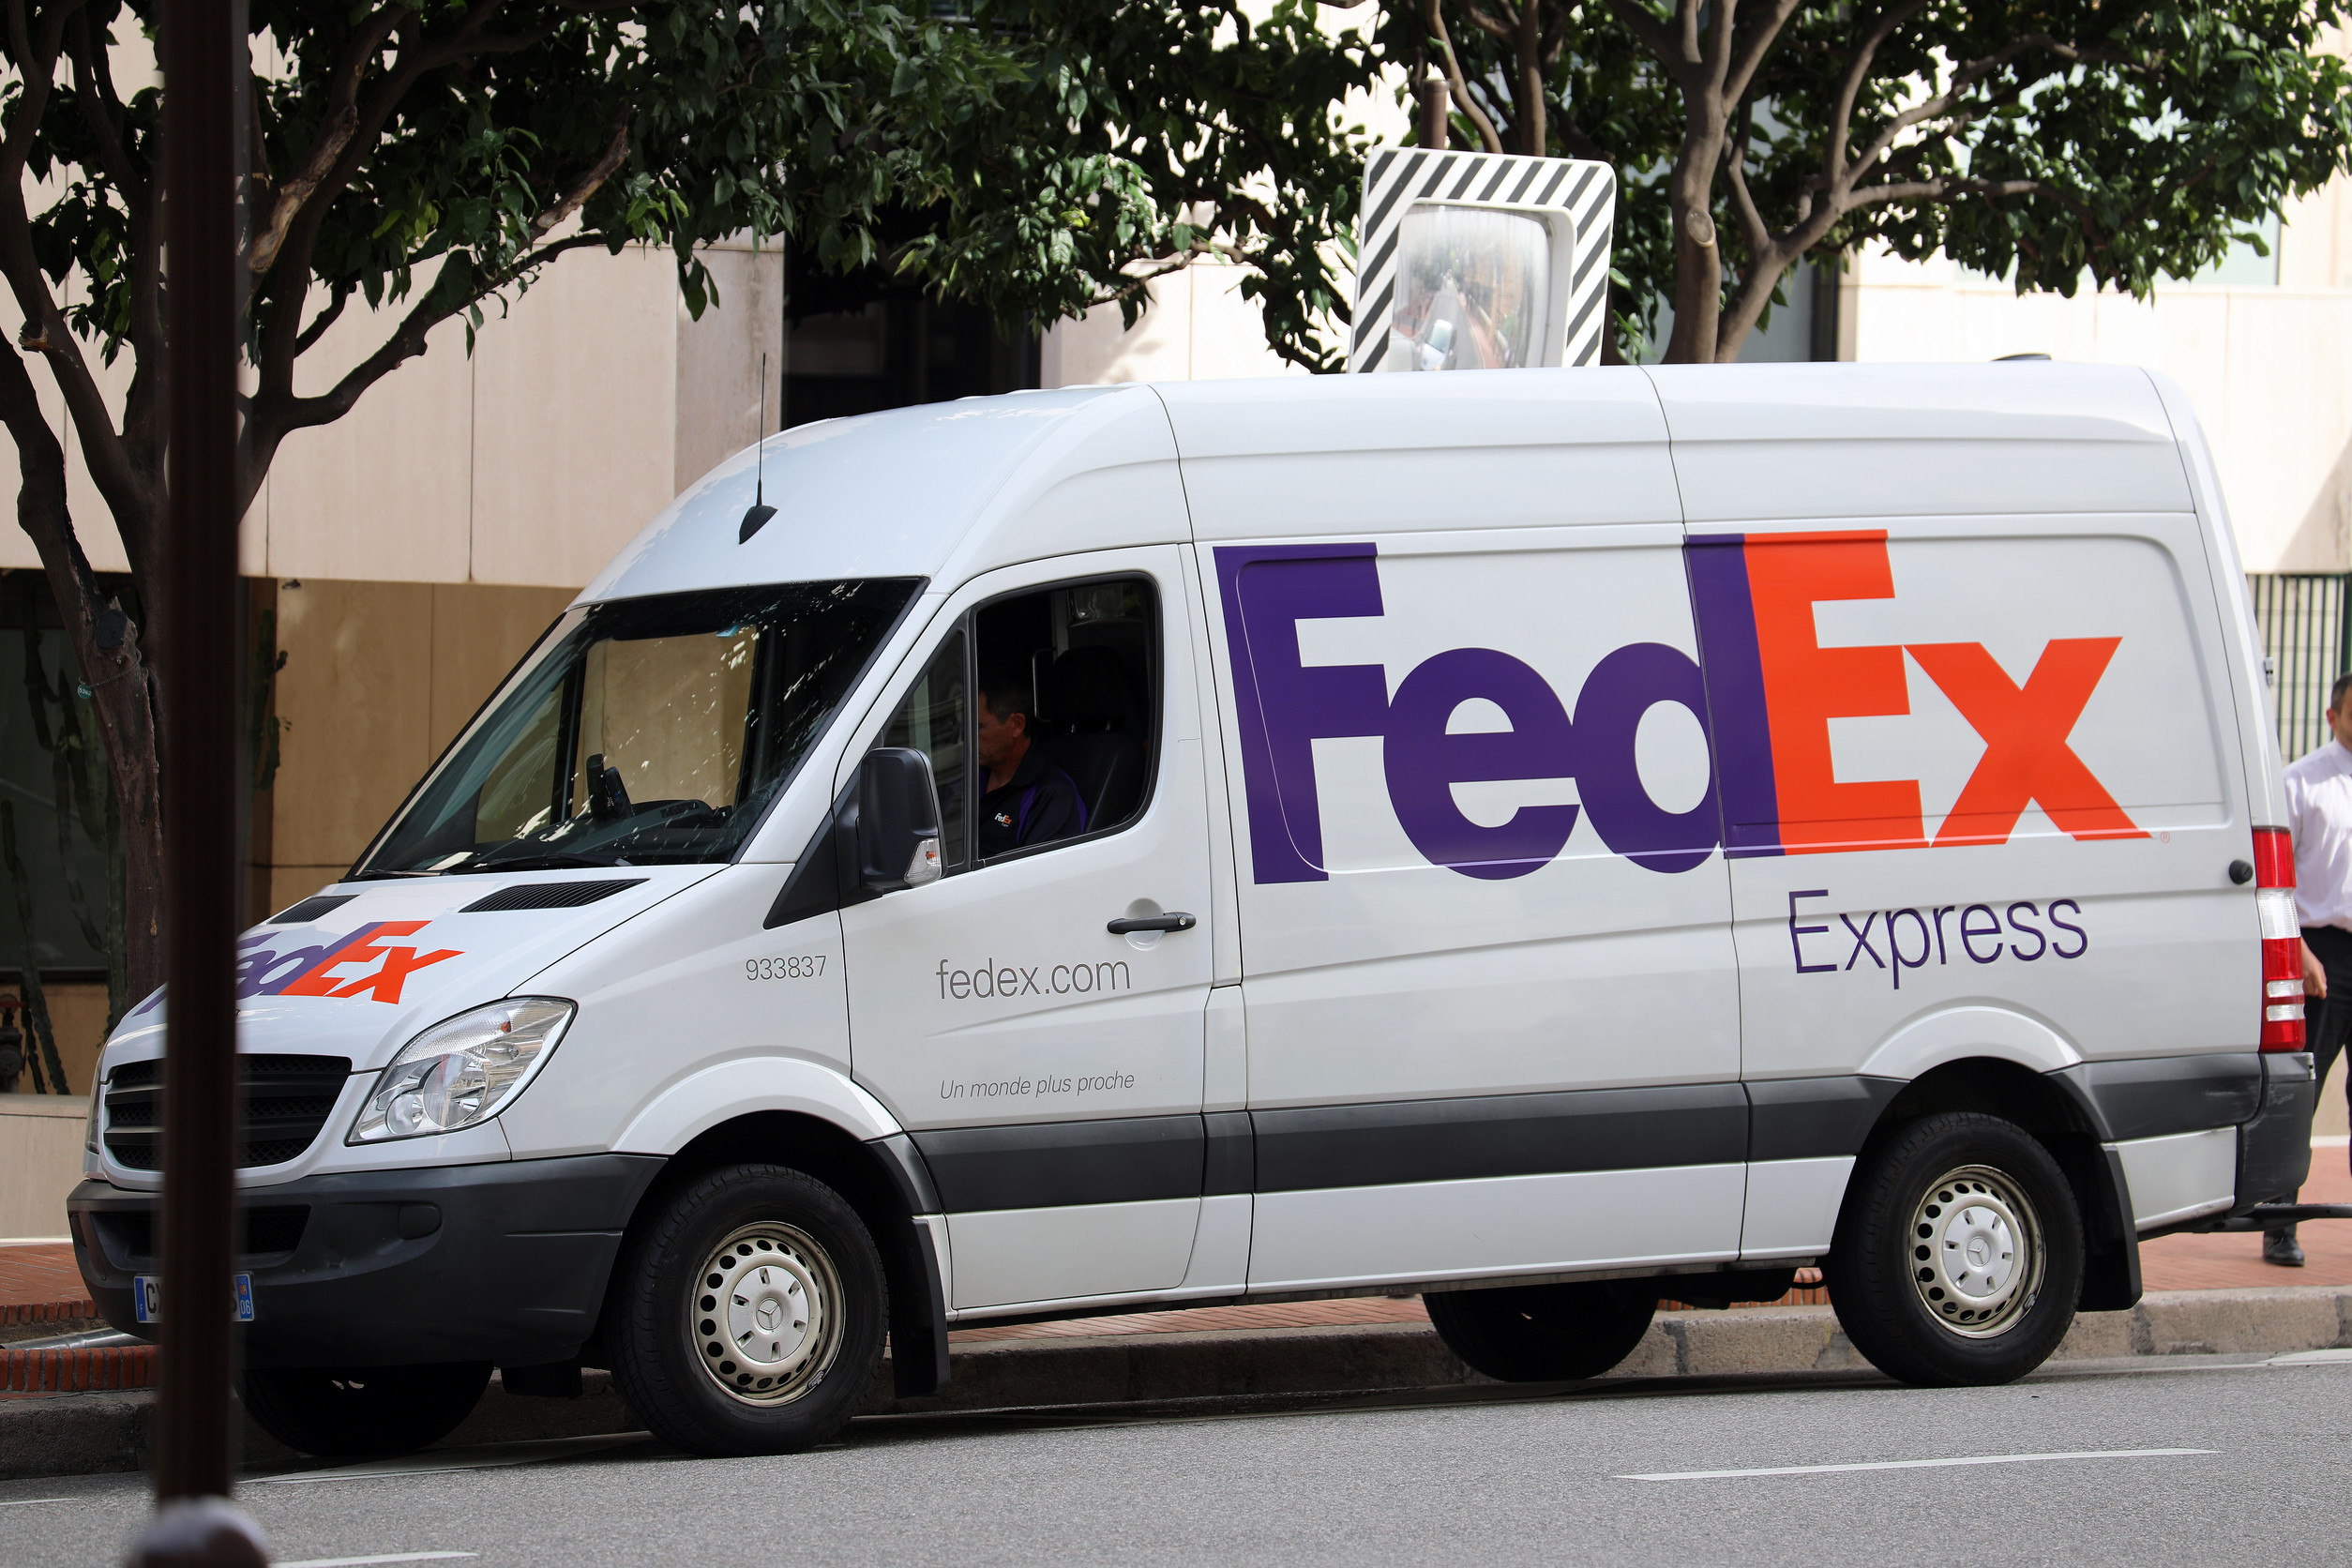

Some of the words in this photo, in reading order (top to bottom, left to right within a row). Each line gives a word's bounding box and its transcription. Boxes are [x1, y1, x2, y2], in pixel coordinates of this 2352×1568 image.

[1212, 529, 2154, 884] FedEx
[994, 812, 1013, 824] FedEx
[1788, 889, 2088, 990] Express
[746, 955, 827, 981] 933837
[935, 957, 1131, 1000] fedex.com
[940, 1079, 965, 1099] Un
[970, 1075, 1032, 1097] monde
[1035, 1073, 1071, 1098] plus
[1076, 1071, 1135, 1096] proche
[239, 1299, 251, 1315] 06
